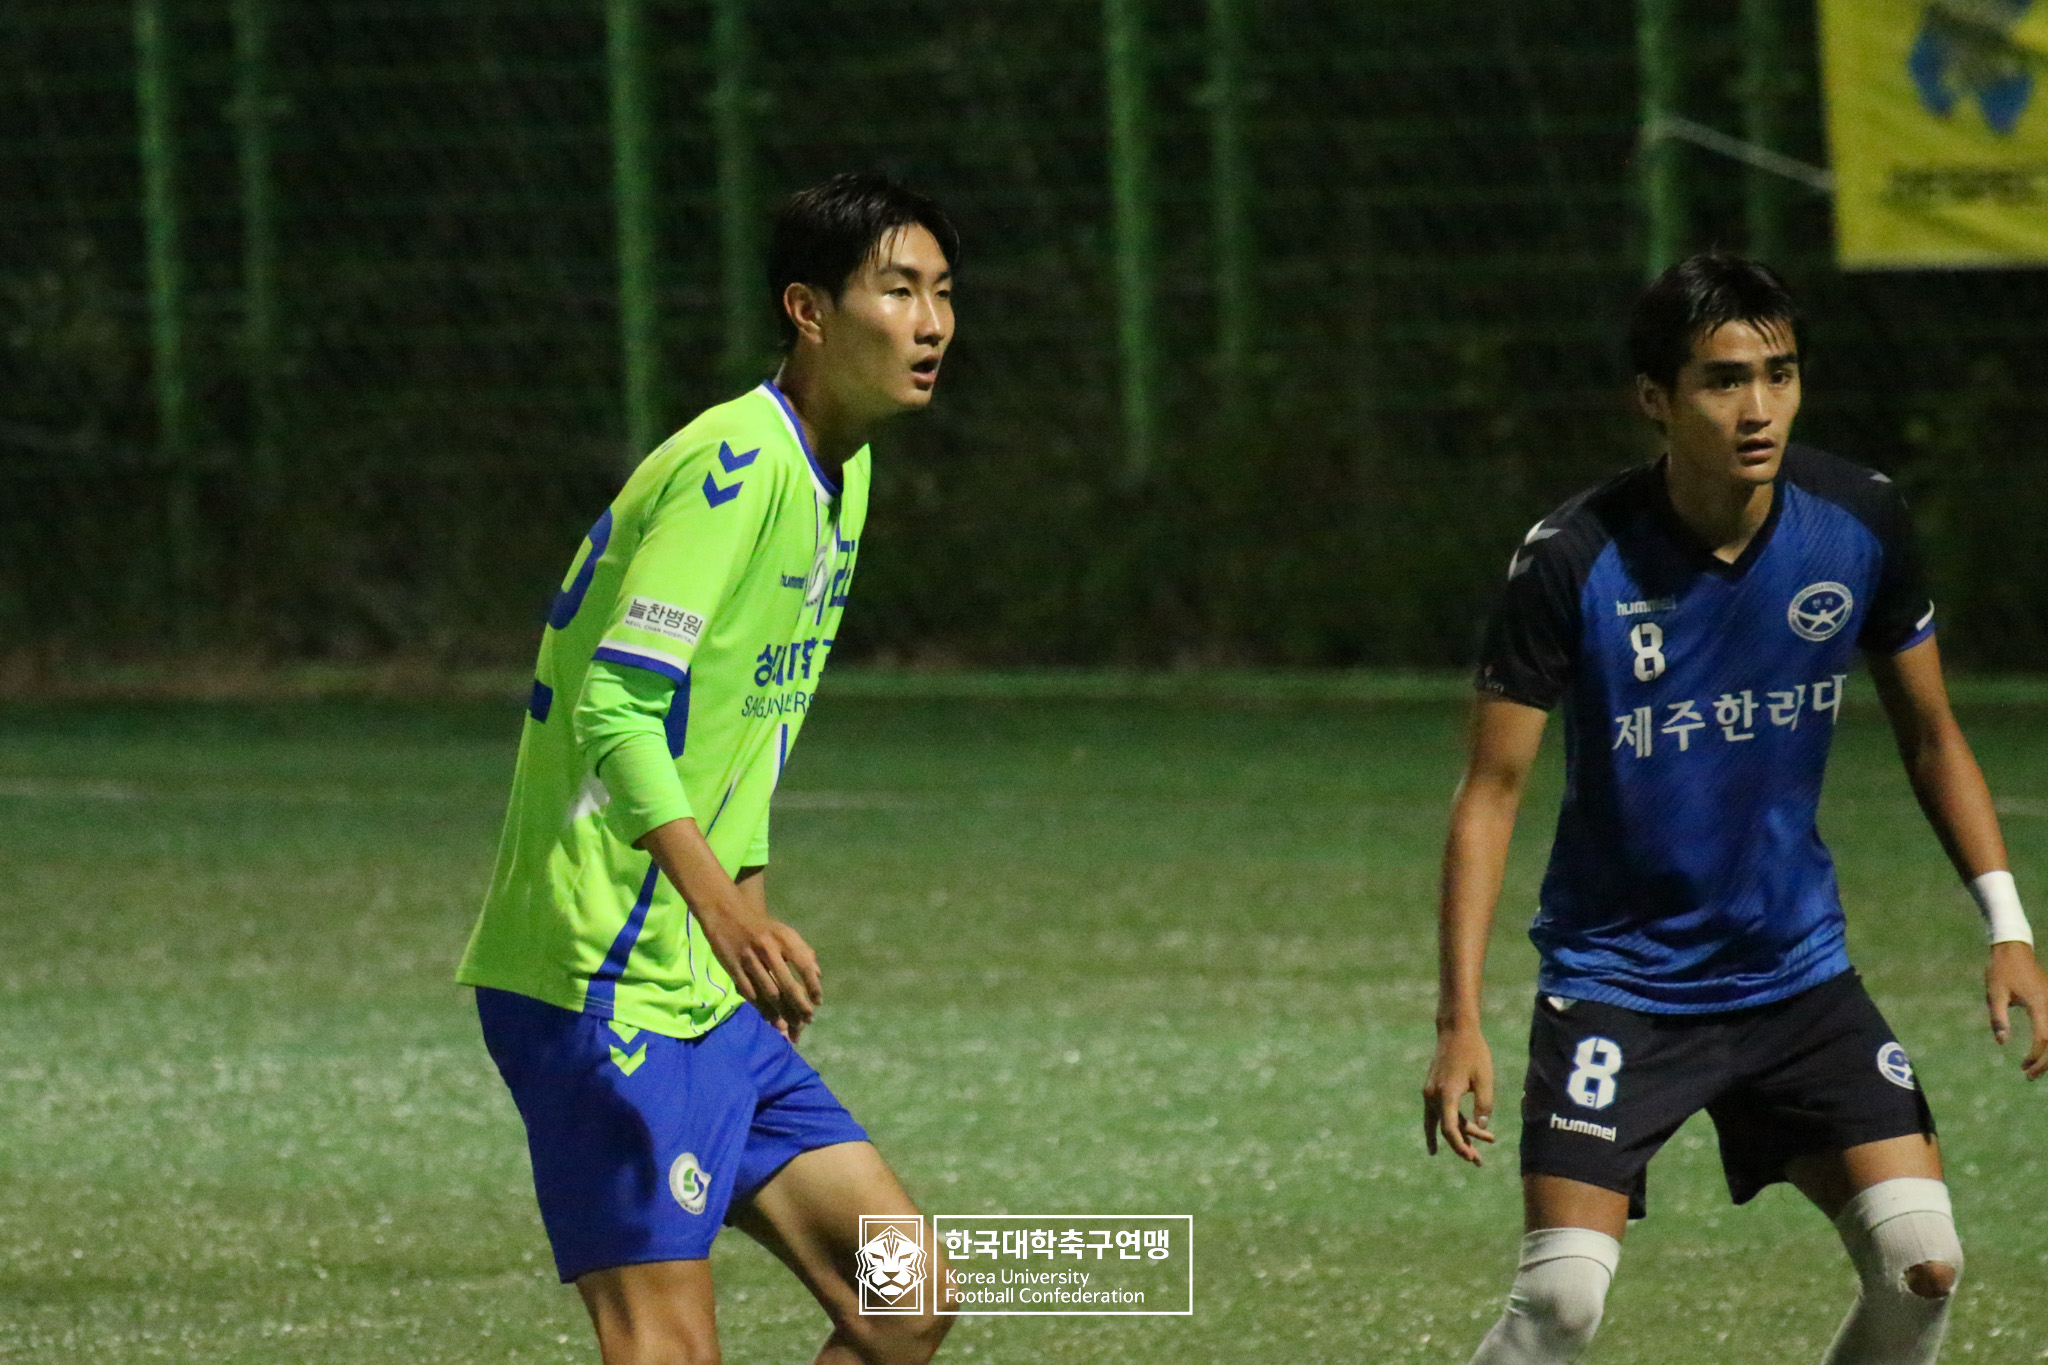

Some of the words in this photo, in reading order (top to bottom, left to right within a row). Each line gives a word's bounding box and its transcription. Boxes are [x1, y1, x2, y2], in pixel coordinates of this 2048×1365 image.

[628, 598, 703, 637] 늘찬병원
[1630, 622, 1666, 682] 8
[1567, 1036, 1623, 1109] 8
[1550, 1113, 1617, 1142] hummel
